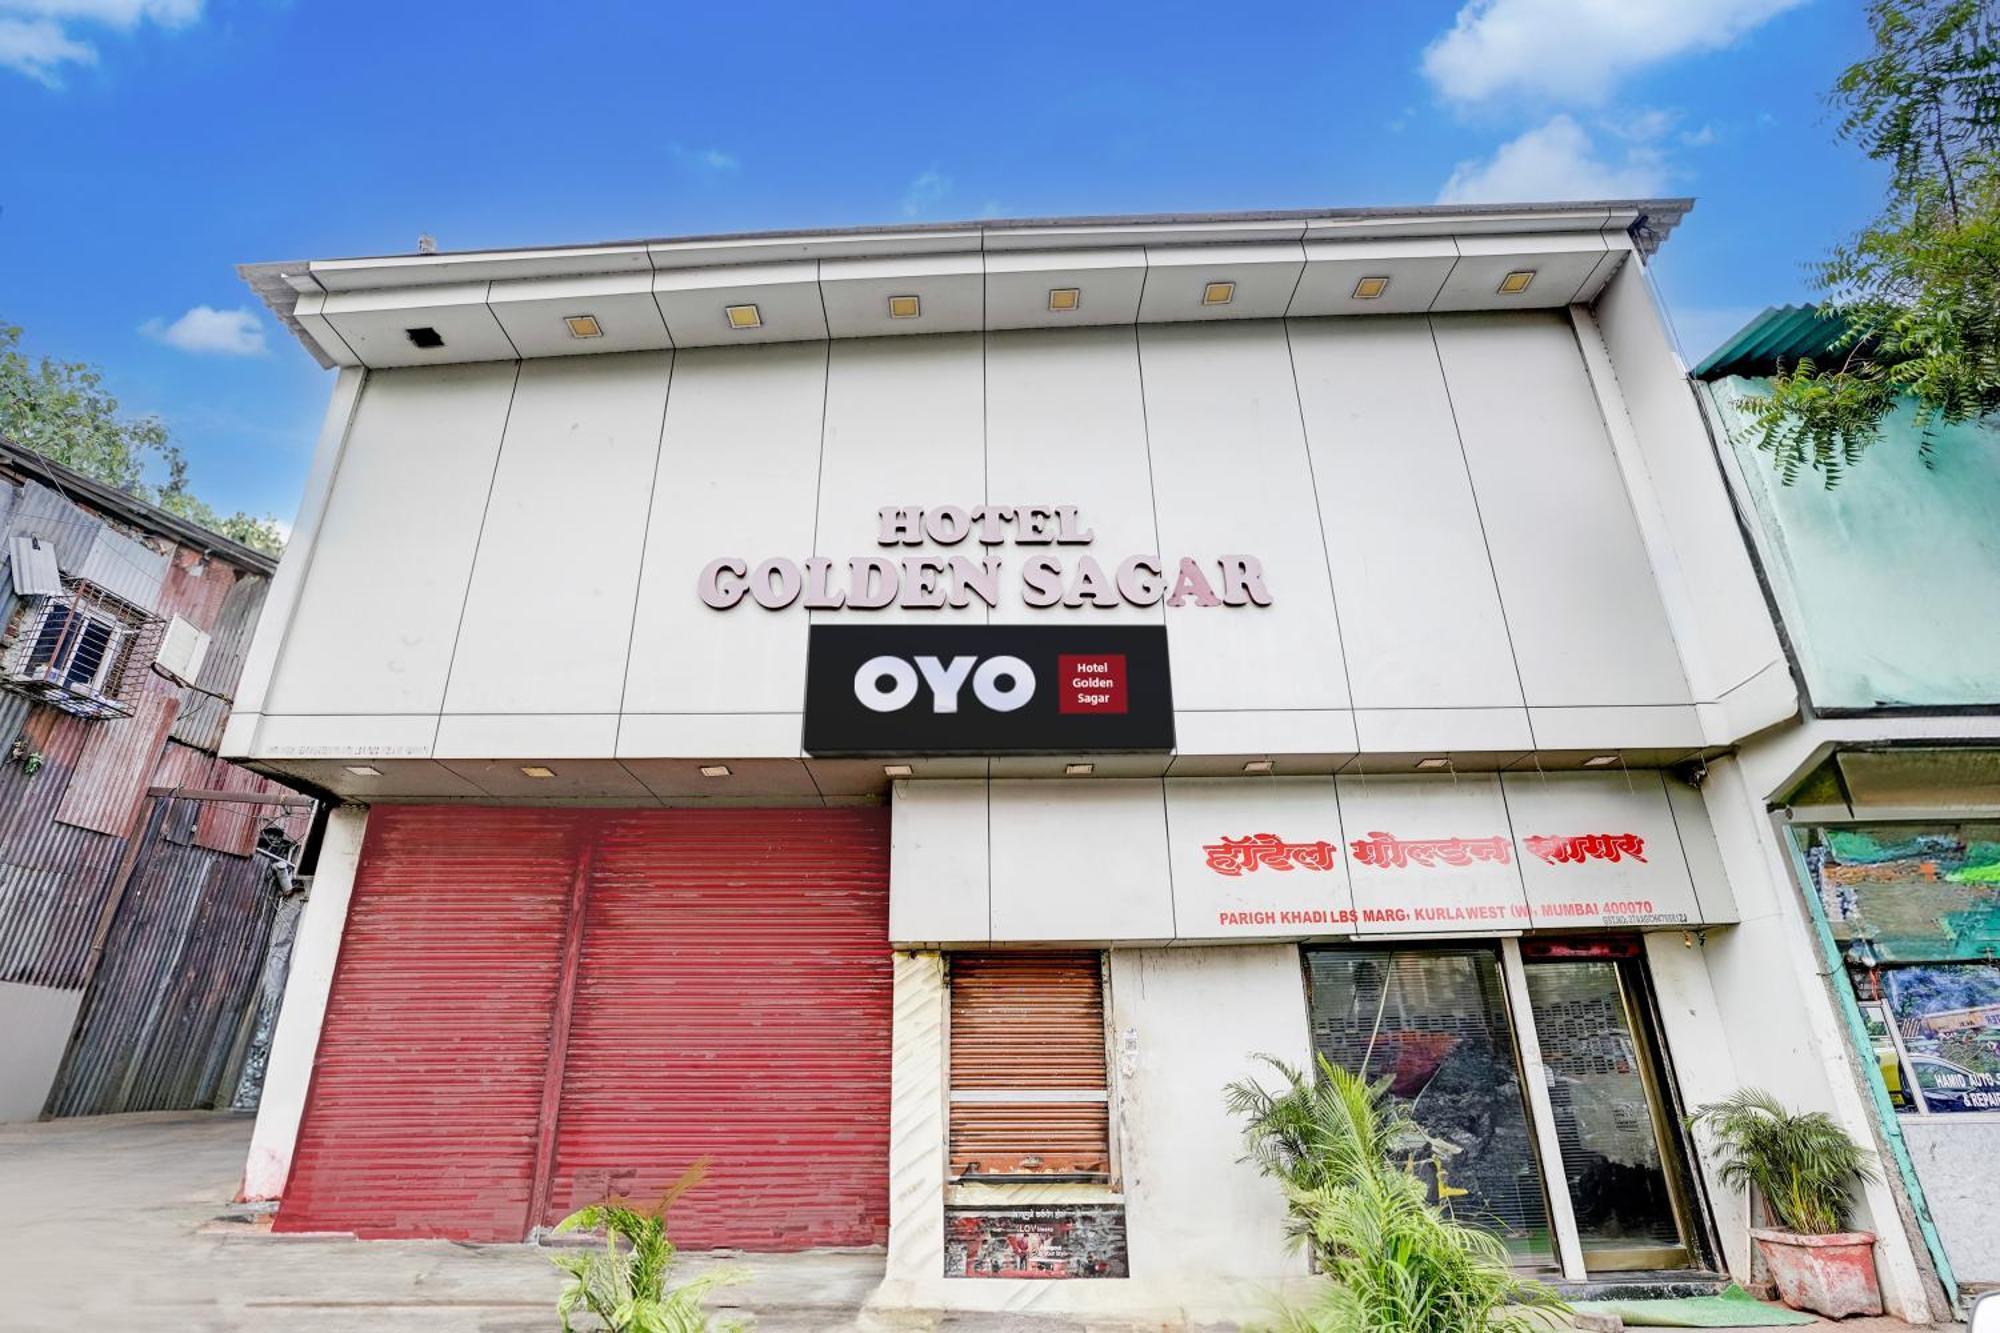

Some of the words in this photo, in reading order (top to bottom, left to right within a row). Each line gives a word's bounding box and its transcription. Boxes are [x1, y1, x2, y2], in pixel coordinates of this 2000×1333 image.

[878, 505, 1093, 546] HOTEL
[697, 555, 1002, 609] GOLDEN
[1023, 553, 1272, 608] SAGAR
[1077, 662, 1108, 673] Hotel
[854, 655, 1036, 713] OYO
[1072, 677, 1113, 688] Golden
[1077, 693, 1110, 706] Sagar
[1202, 833, 1336, 876] हॉटेल
[1350, 831, 1512, 868] गोल्डन
[1523, 833, 1648, 865] सागर
[1281, 910, 1327, 924] KHADI
[1331, 909, 1358, 923] LBS
[1415, 906, 1464, 921] KURLA
[1464, 905, 1506, 920] WEST
[1541, 902, 1599, 917] MUMBAI
[1603, 900, 1653, 915] 400070
[1968, 1072, 1994, 1087] AUTO
